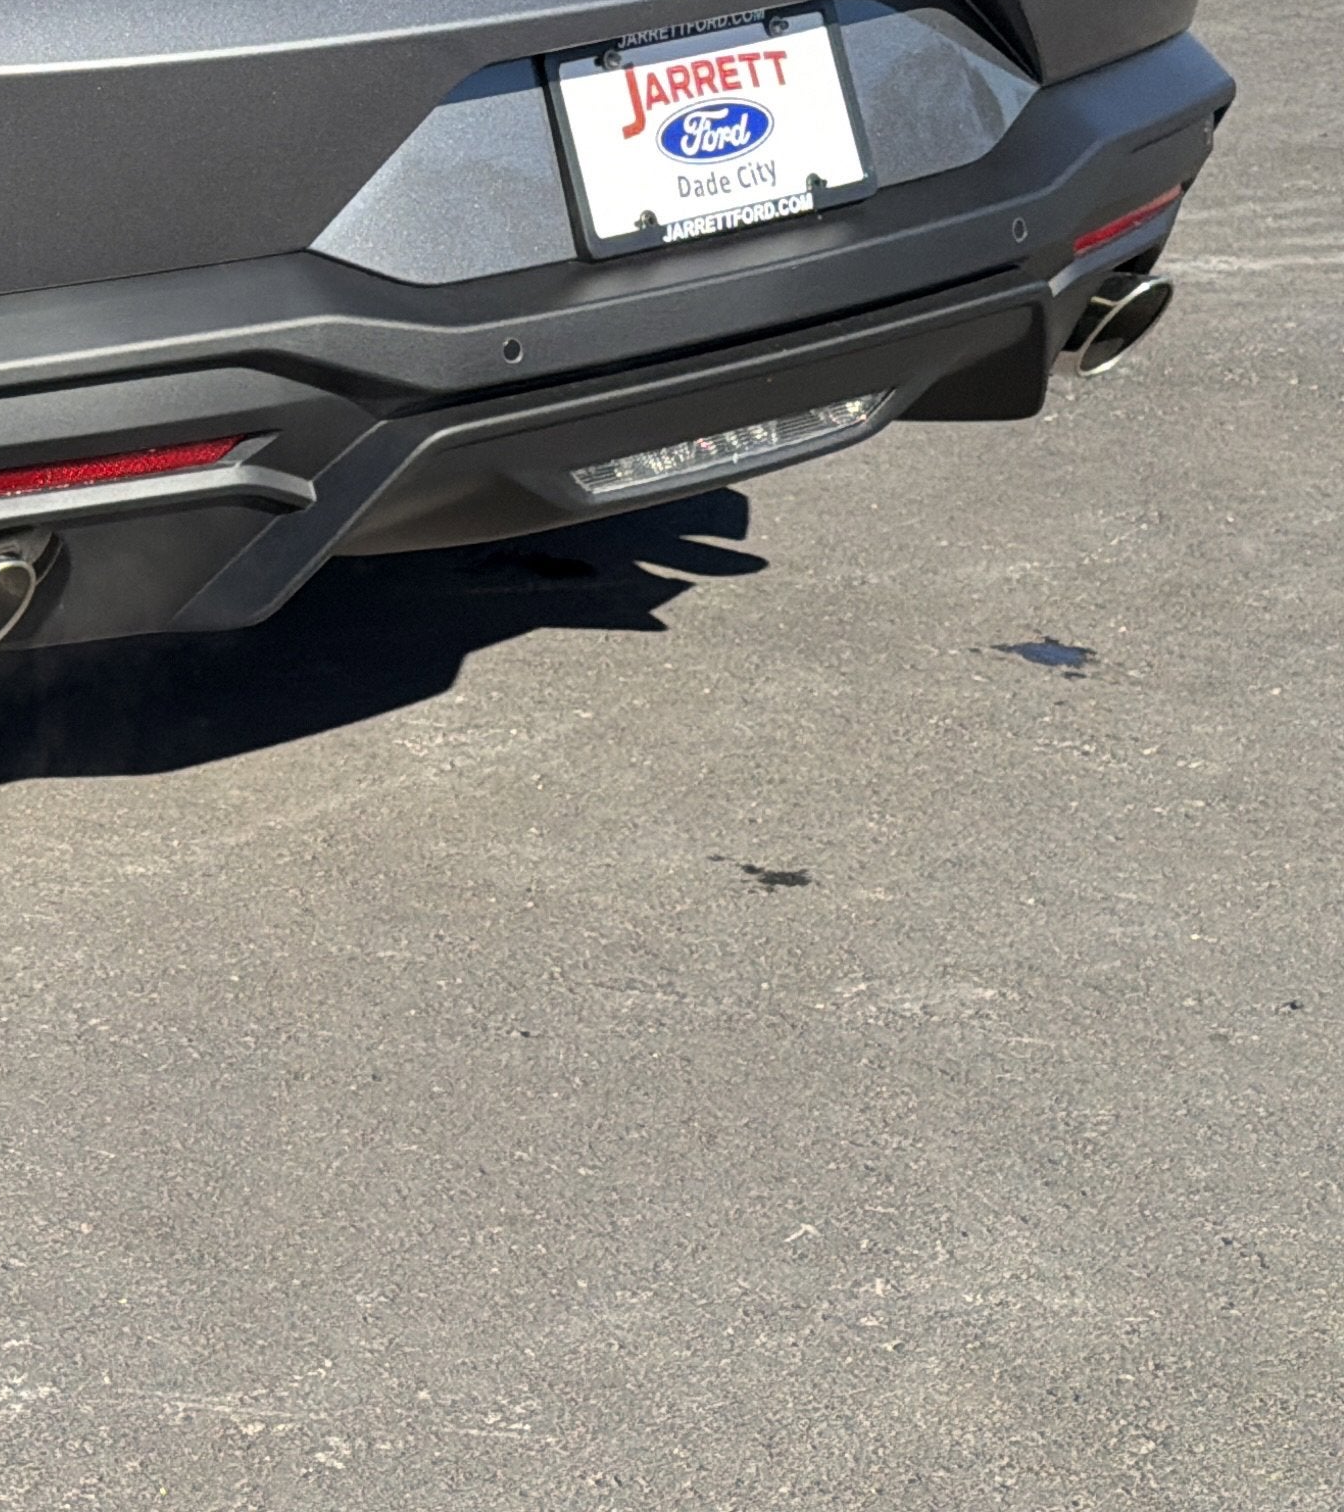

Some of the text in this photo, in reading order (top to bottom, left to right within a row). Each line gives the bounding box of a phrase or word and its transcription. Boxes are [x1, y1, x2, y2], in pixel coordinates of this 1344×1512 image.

[617, 10, 765, 49] JARRETTFORD.COM
[622, 50, 788, 139] JARRETT
[680, 106, 752, 157] Ford
[677, 159, 777, 198] Dade City
[662, 192, 814, 243] JARRETTFORD.COM
